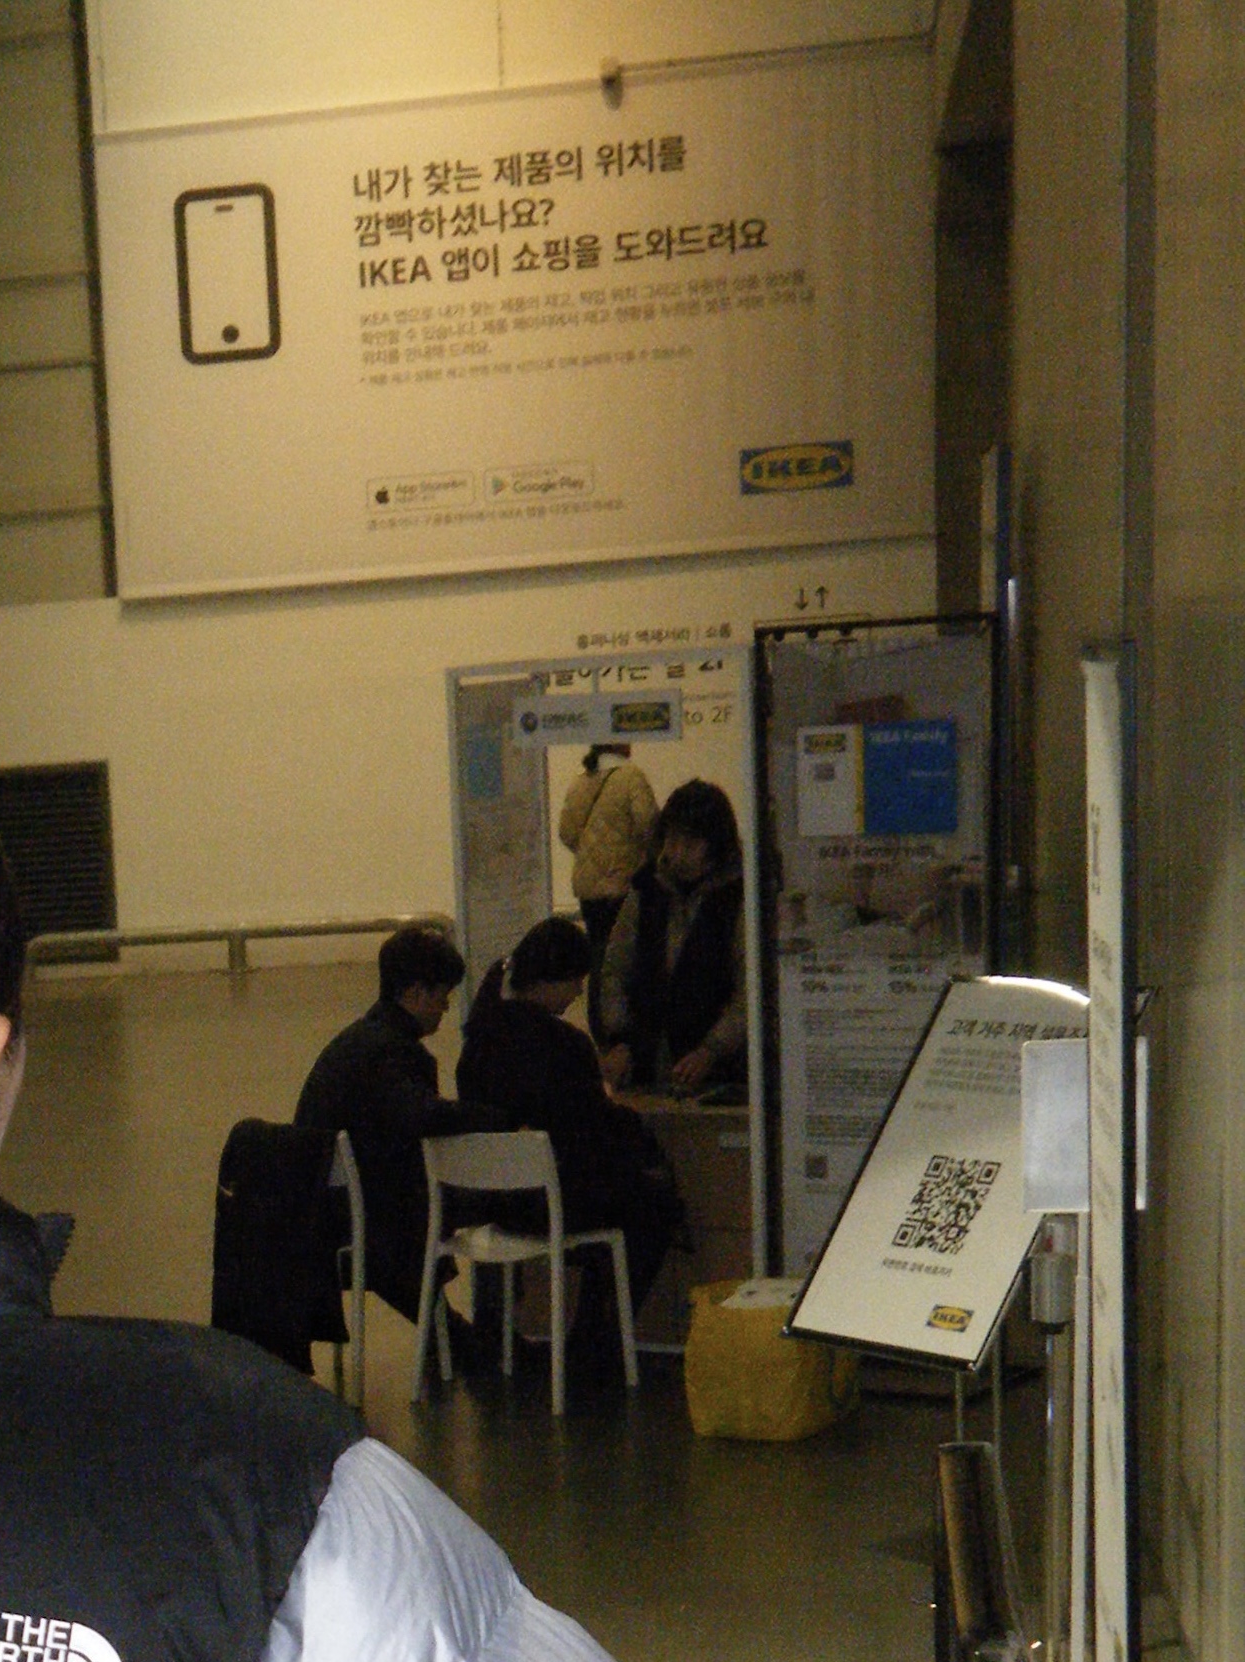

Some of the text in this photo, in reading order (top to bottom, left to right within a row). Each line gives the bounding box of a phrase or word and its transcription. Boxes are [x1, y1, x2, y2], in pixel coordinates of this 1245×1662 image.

[353, 136, 687, 202] 내가 찾는 제품의 위치를
[354, 198, 555, 247] 깜빡하셨나요?
[359, 218, 769, 288] IKEA 앱이 쇼핑을 도와드려요
[751, 450, 845, 480] IKEA
[1, 1612, 71, 1649] THE
